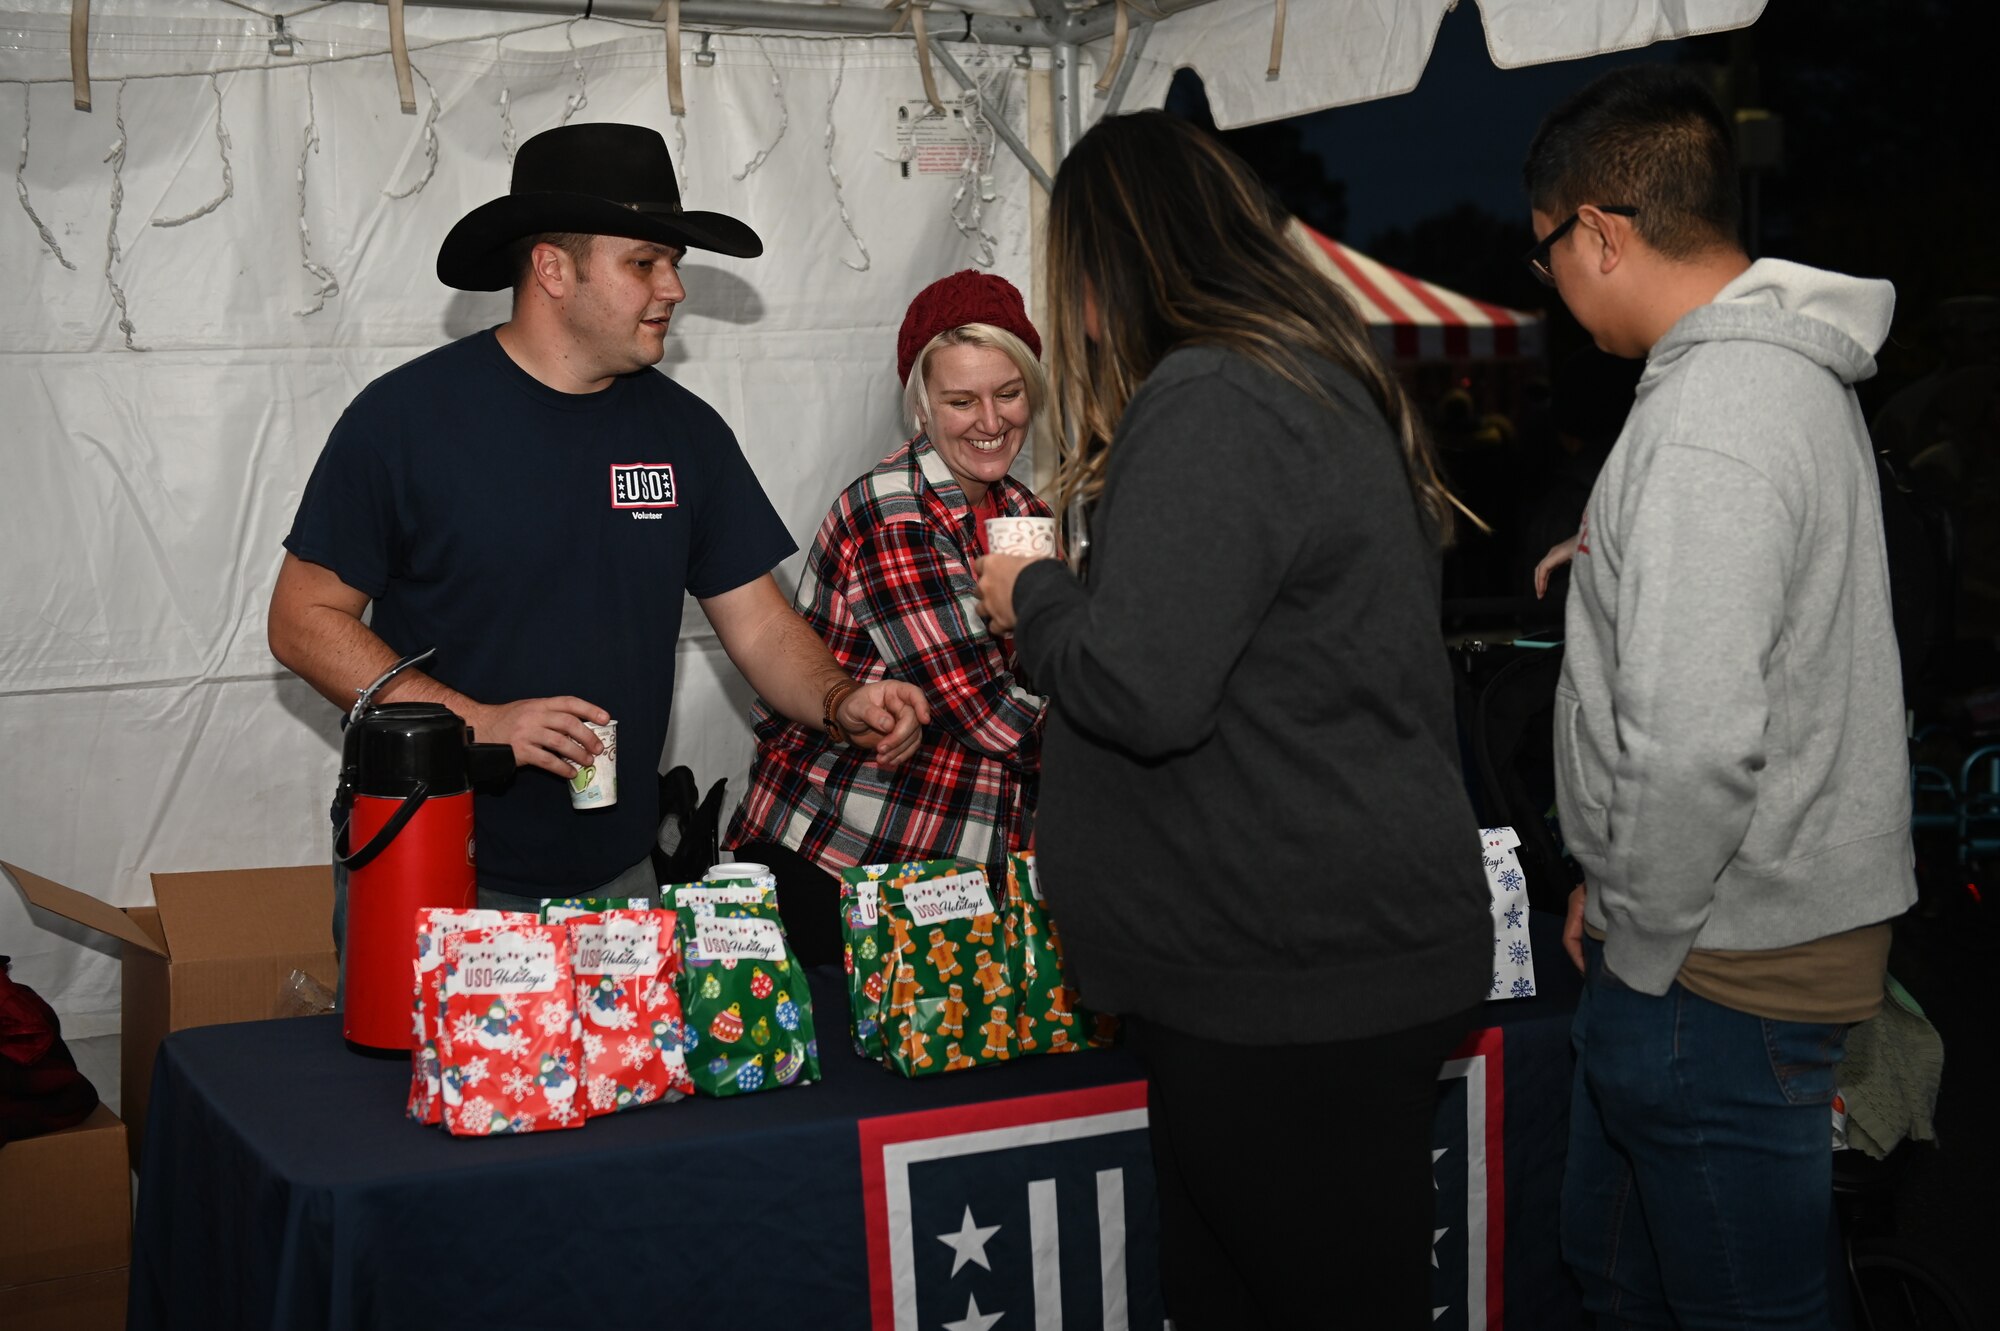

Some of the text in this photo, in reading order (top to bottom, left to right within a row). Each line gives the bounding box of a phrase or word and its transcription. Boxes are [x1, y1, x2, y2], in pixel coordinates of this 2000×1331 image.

[625, 471, 663, 500] USO
[914, 899, 984, 919] USO Holidays
[703, 937, 777, 960] USO Holidays
[599, 950, 650, 974] Holidays
[464, 968, 547, 992] USO Holidays
